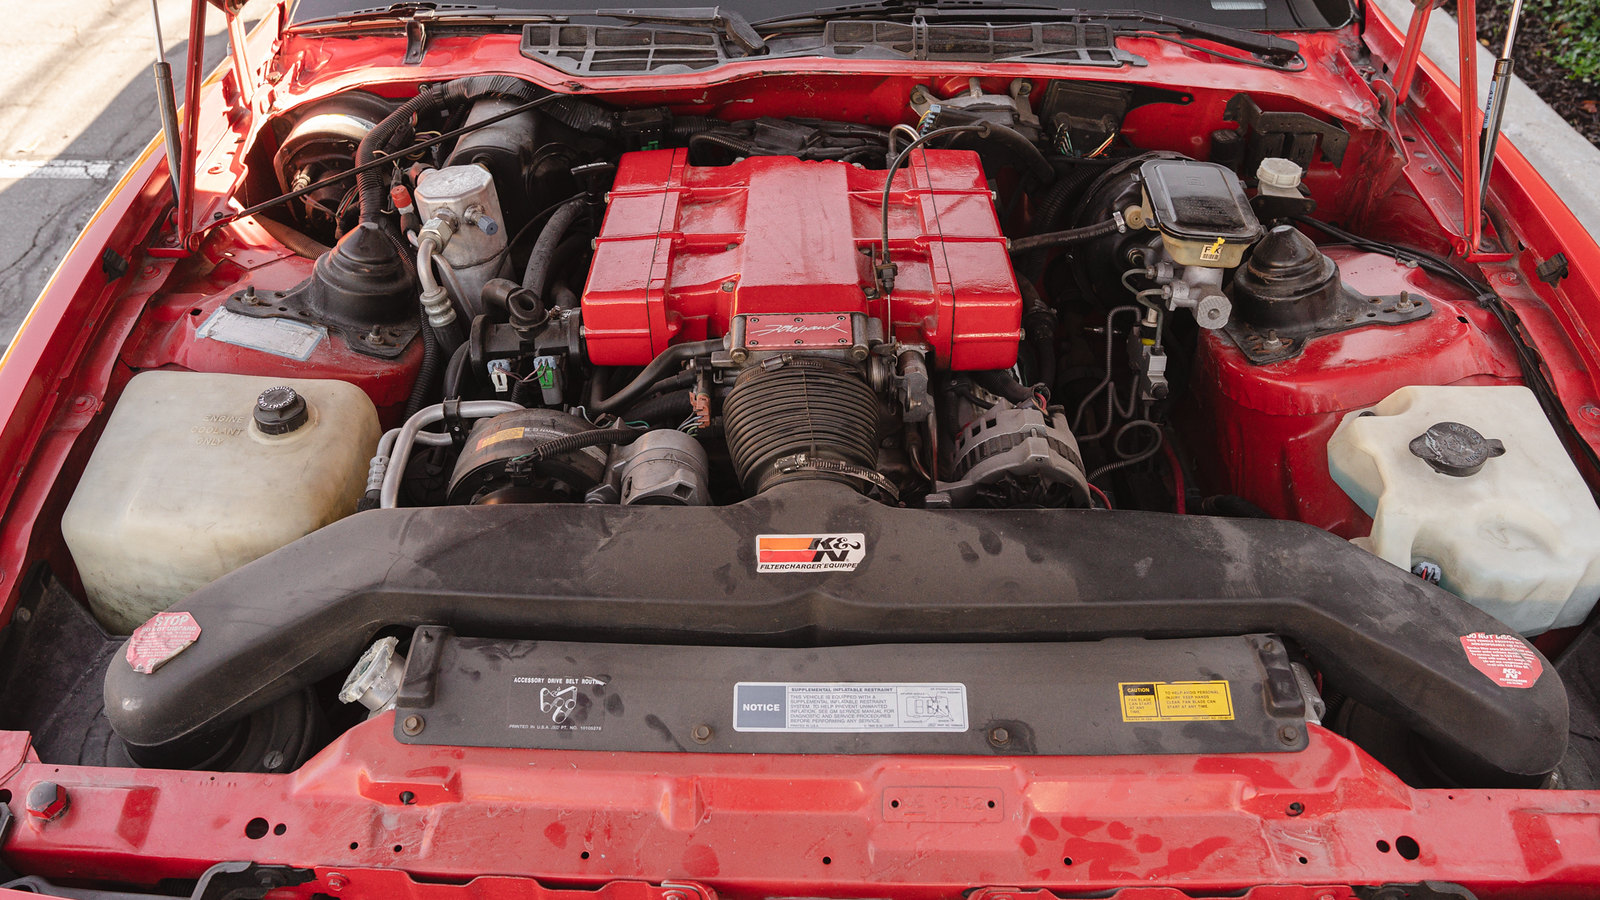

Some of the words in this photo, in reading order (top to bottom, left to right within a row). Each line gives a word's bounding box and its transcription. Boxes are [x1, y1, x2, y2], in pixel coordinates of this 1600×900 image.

[269, 391, 296, 409] COOLANT
[191, 426, 244, 436] COOLANT
[196, 438, 224, 446] ONLY
[808, 537, 861, 562] K&N
[154, 615, 189, 626] STOP
[743, 704, 780, 712] NOTICE
